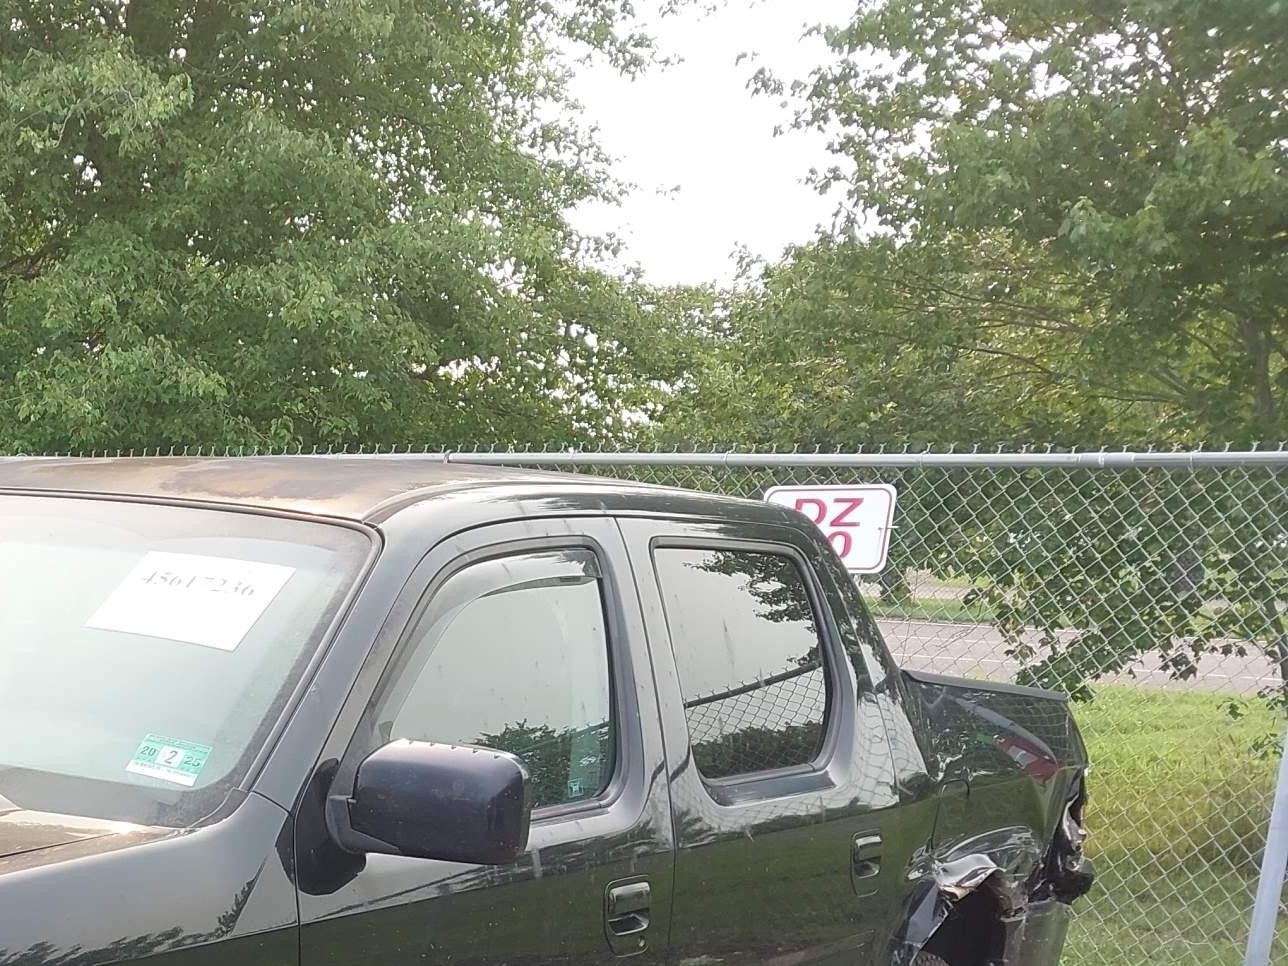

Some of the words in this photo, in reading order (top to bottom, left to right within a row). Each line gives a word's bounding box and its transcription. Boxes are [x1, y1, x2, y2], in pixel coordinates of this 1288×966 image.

[795, 498, 864, 527] DZ
[140, 745, 157, 756] 20
[164, 750, 178, 764] 2
